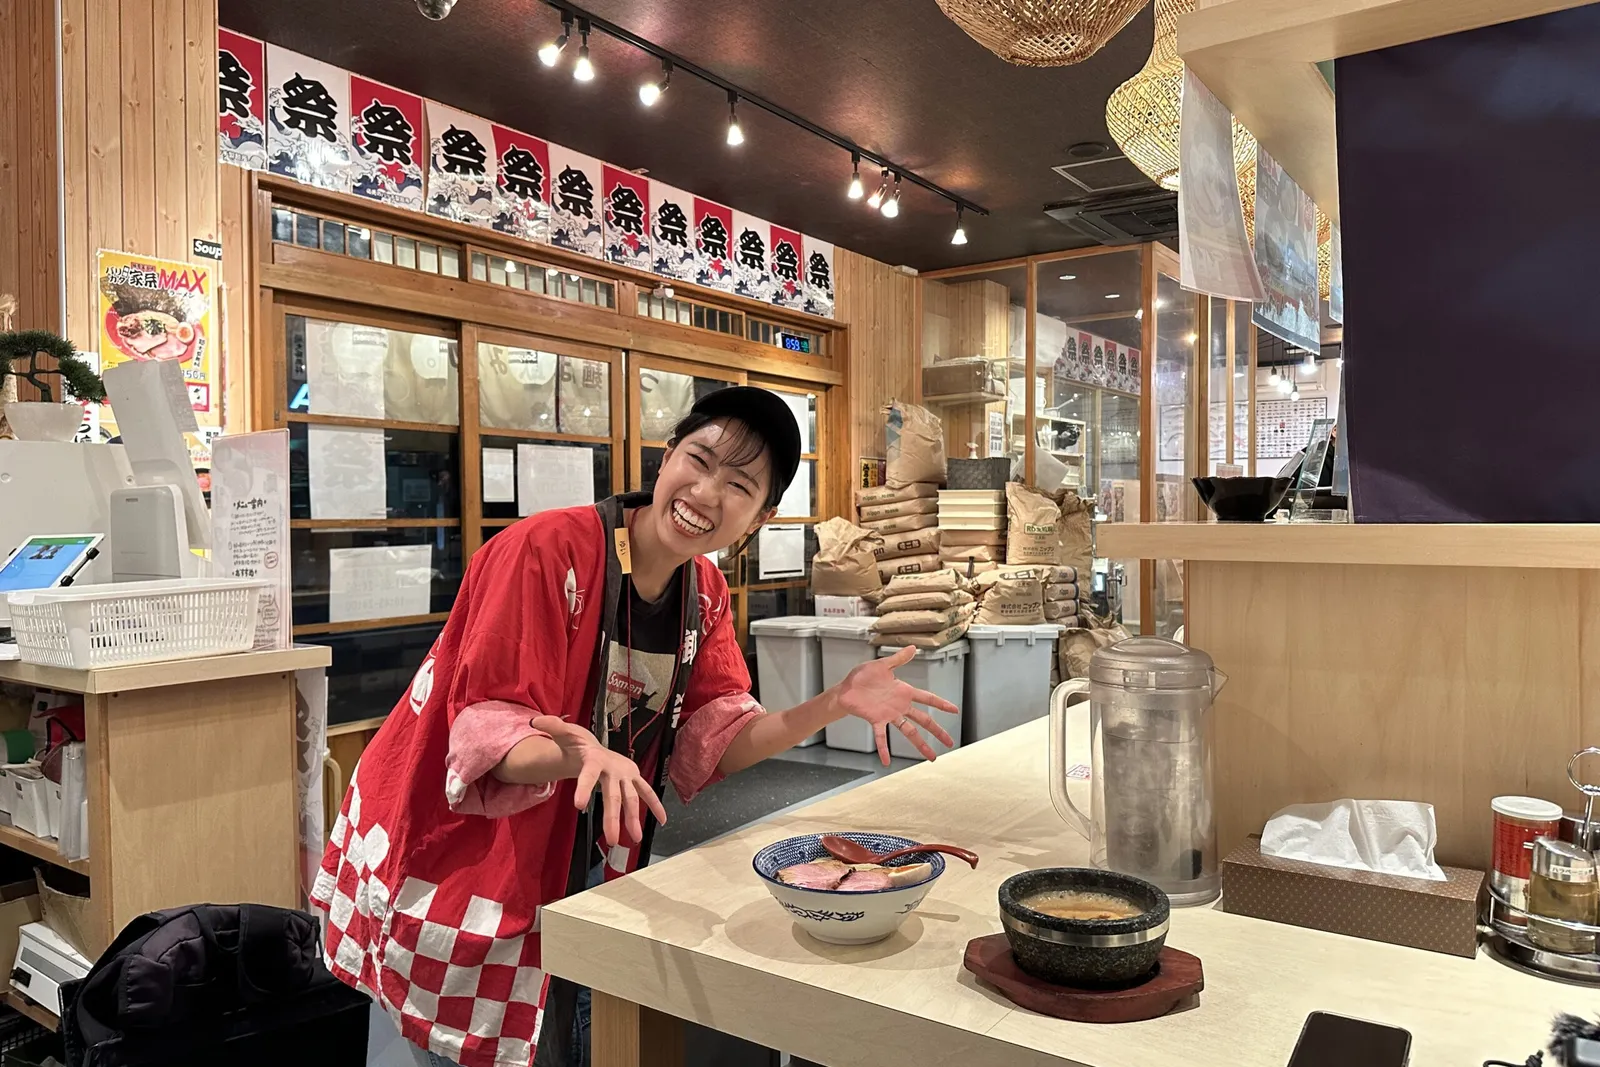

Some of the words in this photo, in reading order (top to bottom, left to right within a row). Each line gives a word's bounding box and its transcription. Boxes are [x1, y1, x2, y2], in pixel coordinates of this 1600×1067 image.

[219, 51, 251, 118] 祭
[282, 72, 338, 143] 祭
[363, 100, 413, 165] 祭
[442, 124, 487, 184] 祭
[502, 145, 544, 203] 祭
[558, 165, 593, 219] 祭
[611, 184, 644, 235] 祭
[658, 199, 688, 248] 祭
[701, 215, 727, 260] 祭
[739, 227, 765, 271] 祭
[776, 240, 798, 281] 祭
[159, 268, 206, 294] MAX
[809, 250, 829, 290] 祭
